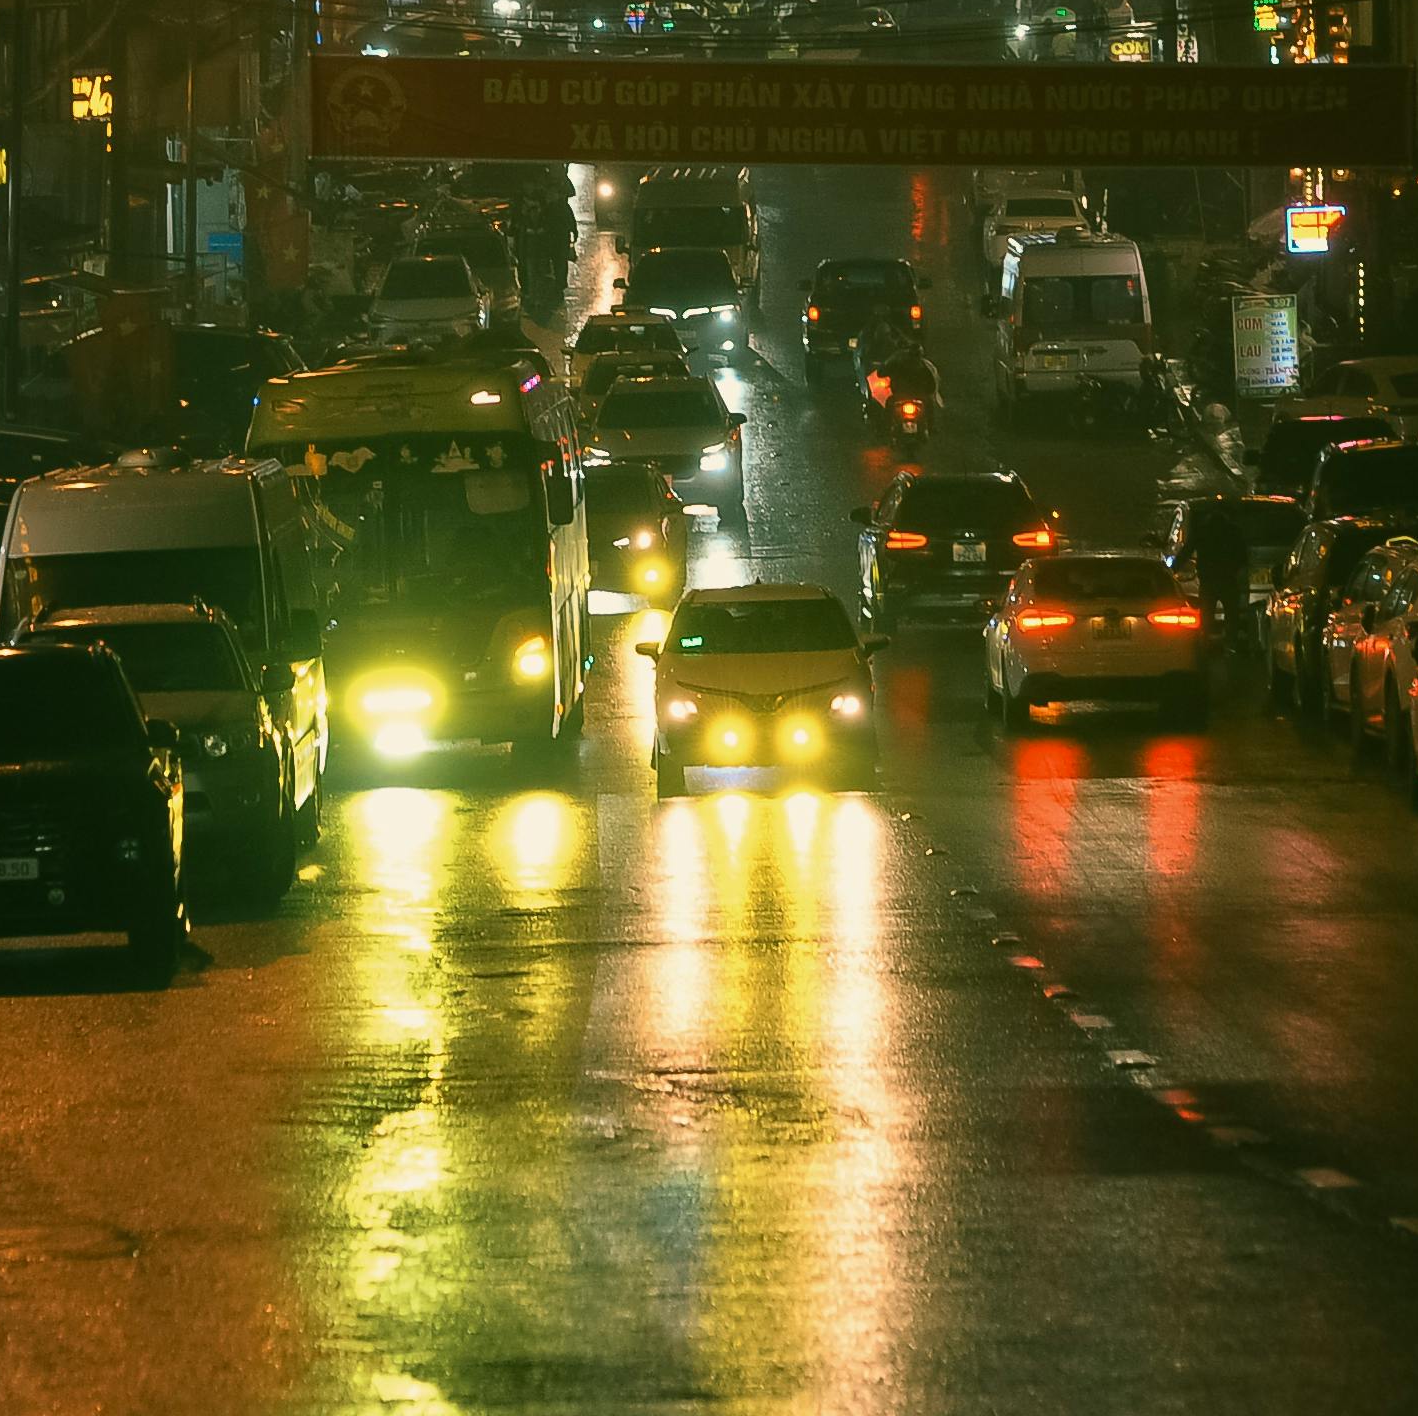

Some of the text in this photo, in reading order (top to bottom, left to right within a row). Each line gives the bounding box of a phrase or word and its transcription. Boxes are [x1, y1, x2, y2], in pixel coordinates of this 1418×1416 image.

[483, 69, 549, 105] BẦU
[560, 72, 607, 105] CỬ
[615, 74, 679, 106] GÓP
[691, 71, 781, 109] PHẦN
[791, 78, 856, 110] XÂY
[568, 120, 614, 151] XÃ
[624, 122, 679, 159] HỘI
[691, 118, 757, 153] CHỦ
[766, 122, 868, 154] NGHĨA
[878, 124, 946, 160] VIỆT
[956, 127, 1033, 156] NAM
